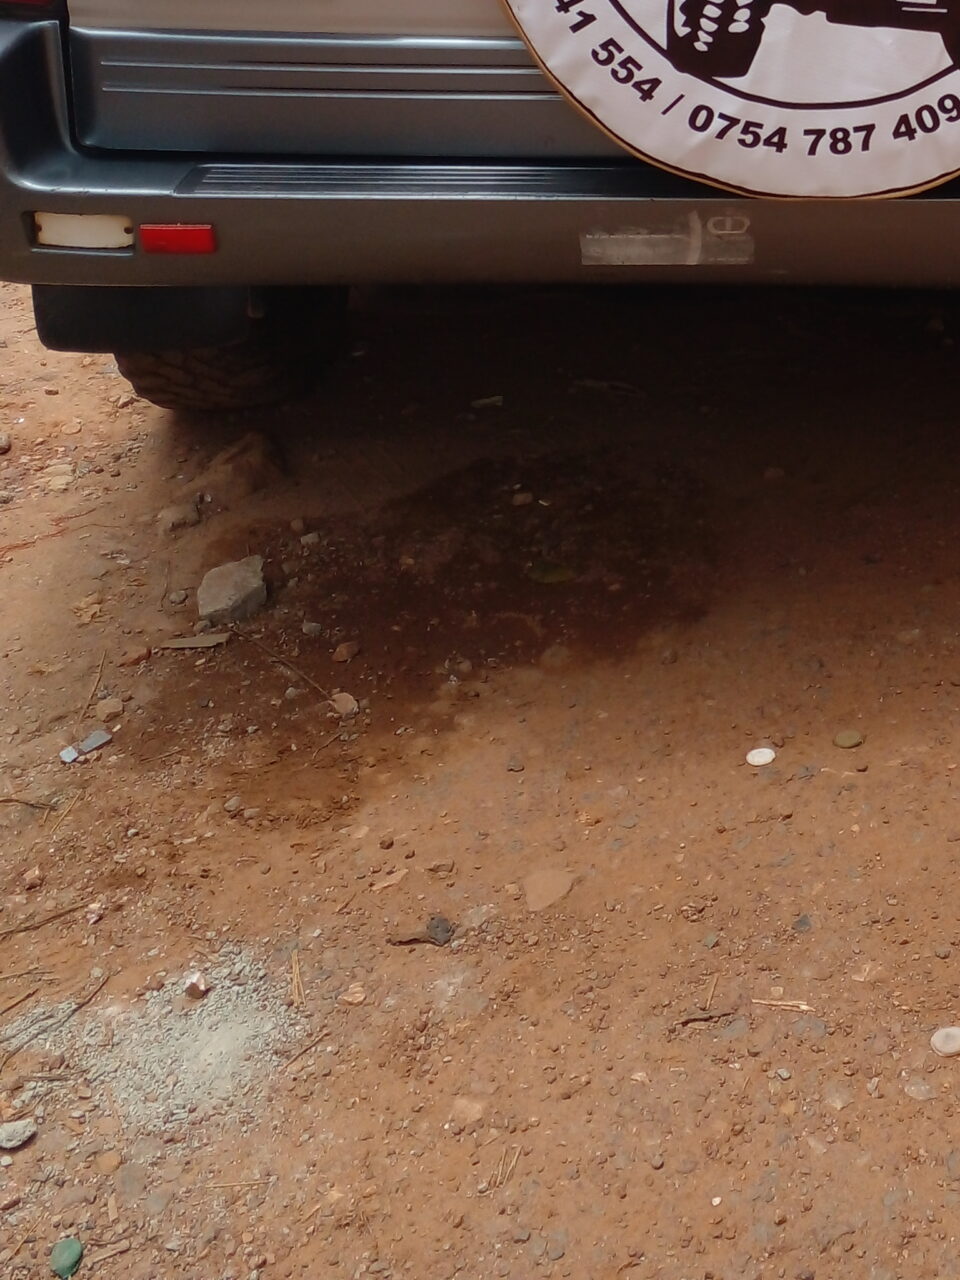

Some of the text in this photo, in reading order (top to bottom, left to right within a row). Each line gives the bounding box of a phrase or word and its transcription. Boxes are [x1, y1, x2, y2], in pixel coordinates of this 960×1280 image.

[590, 36, 663, 103] 554
[687, 104, 789, 154] 0754
[802, 122, 877, 157] 787
